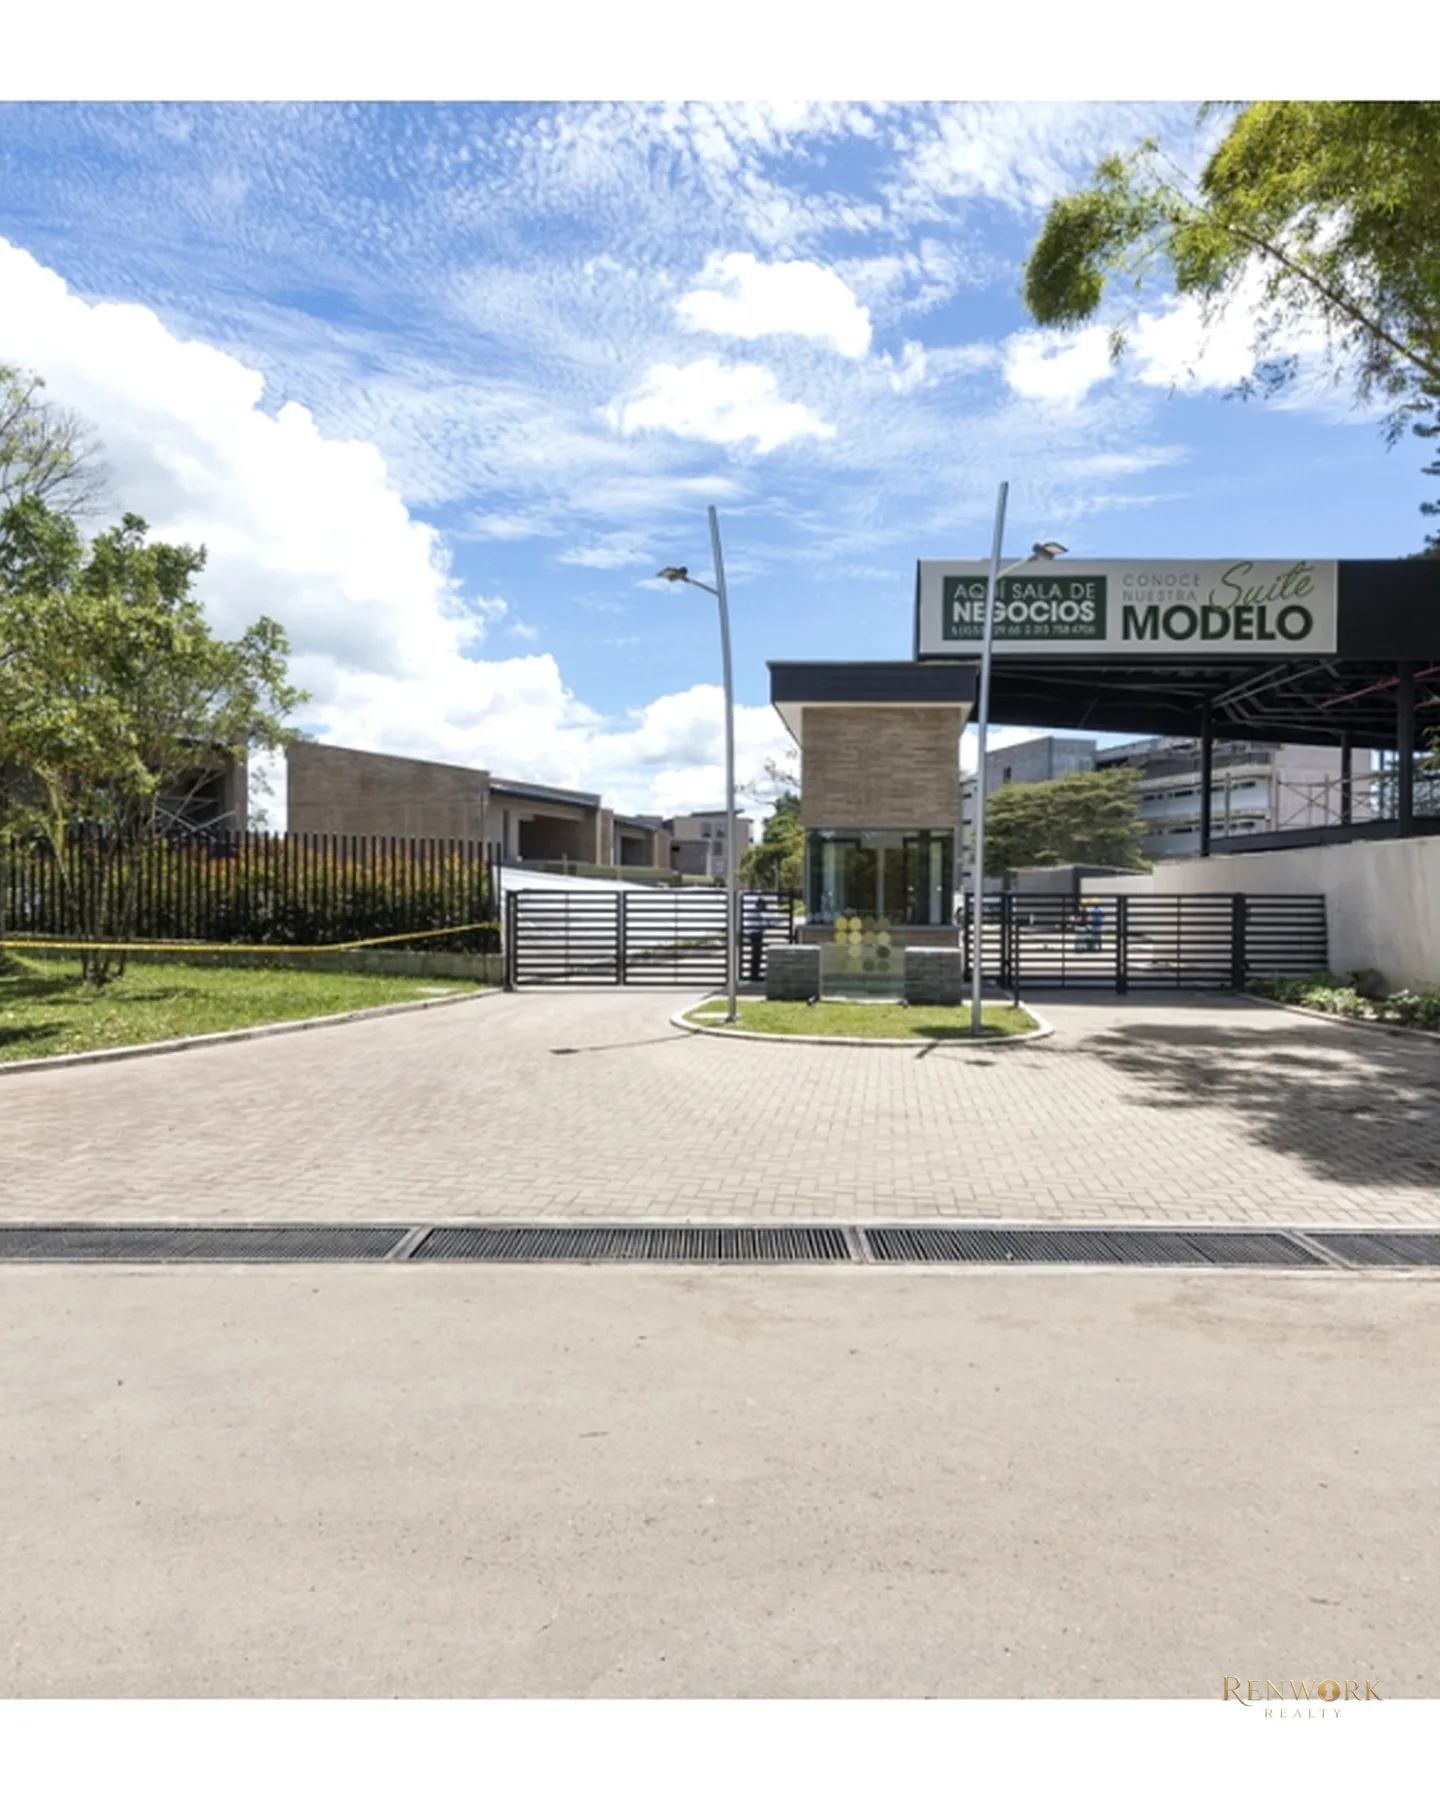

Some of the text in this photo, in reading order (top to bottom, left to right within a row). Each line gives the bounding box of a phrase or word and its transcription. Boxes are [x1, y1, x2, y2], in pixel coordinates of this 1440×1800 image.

[1123, 573, 1201, 587] CONOCE
[1208, 560, 1315, 612] Suite
[1012, 583, 1063, 599] SALA
[1070, 583, 1096, 599] DE
[1123, 589, 1197, 602] NUESTRA
[952, 601, 1096, 623] NEGOCIOS
[1122, 604, 1314, 641] MODELO
